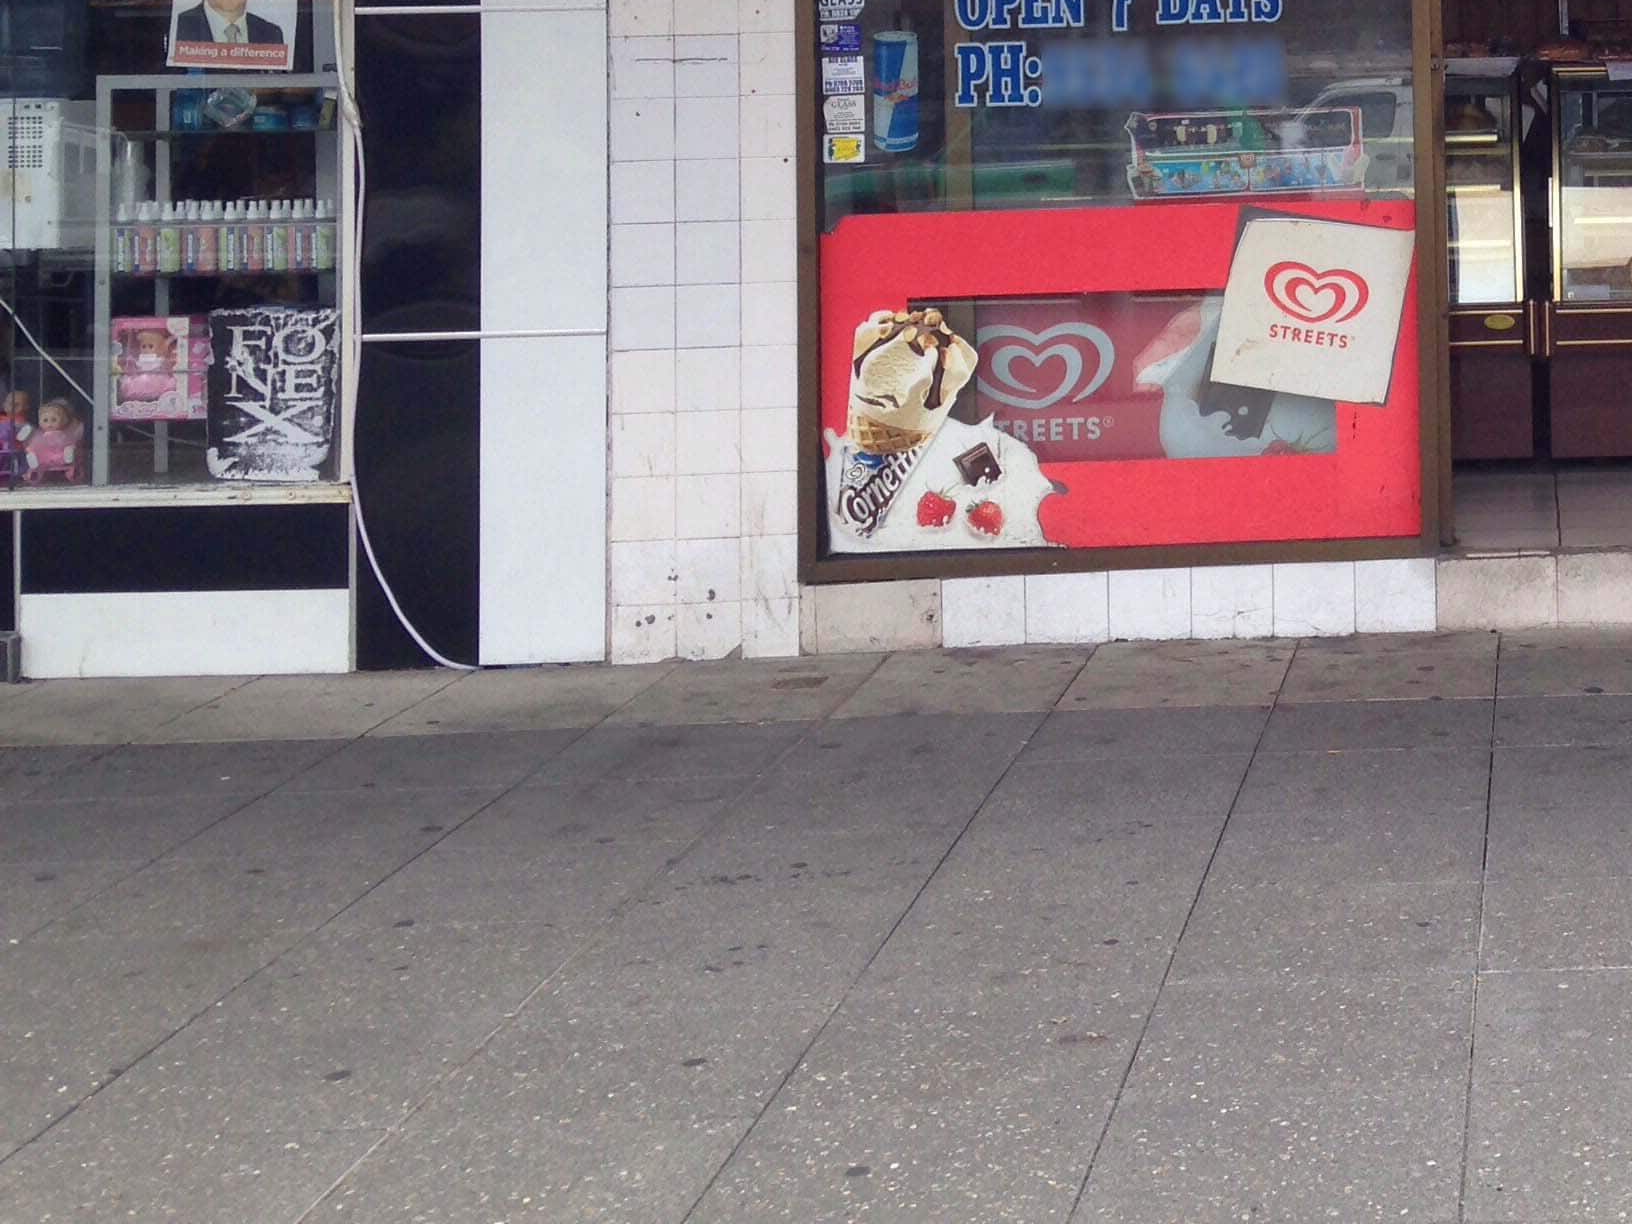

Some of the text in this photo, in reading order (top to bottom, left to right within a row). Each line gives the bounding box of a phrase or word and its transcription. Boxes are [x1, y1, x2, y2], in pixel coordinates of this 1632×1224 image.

[230, 47, 285, 59] difference
[955, 40, 1042, 107] PH:
[1269, 323, 1349, 350] STREETS
[994, 416, 1101, 442] TREETS
[841, 447, 920, 532] Cornett
